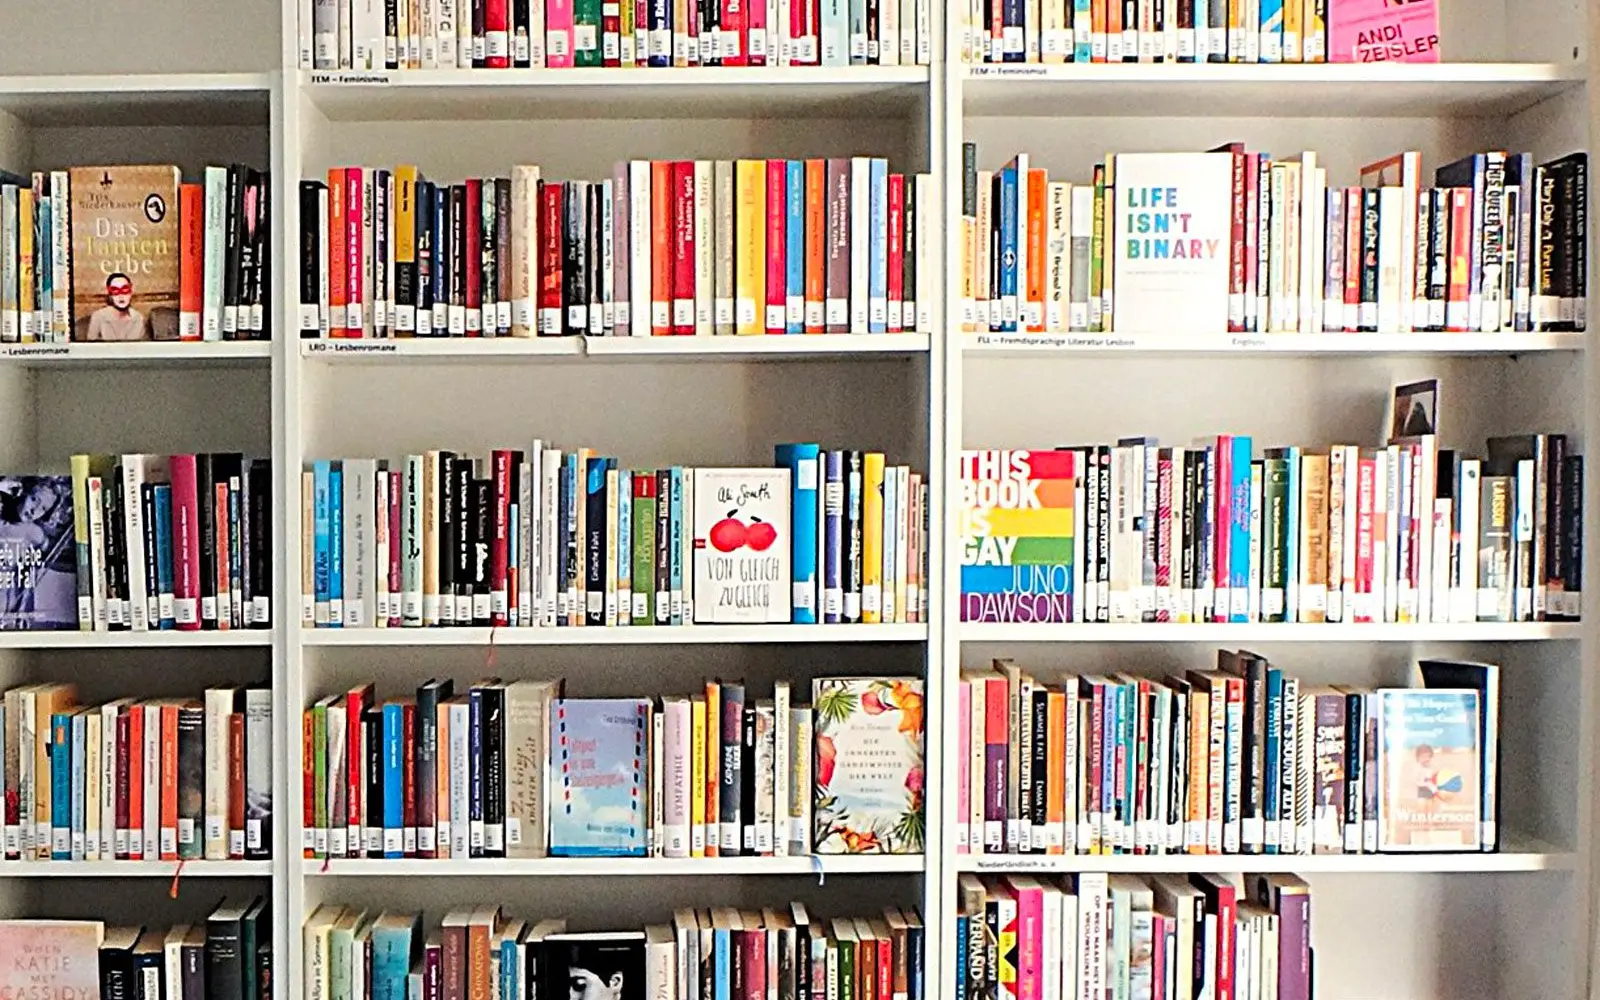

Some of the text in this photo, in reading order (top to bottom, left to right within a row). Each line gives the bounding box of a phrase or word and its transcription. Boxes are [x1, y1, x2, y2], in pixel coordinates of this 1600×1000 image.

[1357, 24, 1403, 46] ANDI
[339, 75, 389, 83] Feminismus
[998, 67, 1047, 75] Feminismus
[1128, 188, 1178, 208] LIFE
[1541, 178, 1555, 202] Mary
[1488, 190, 1502, 226] QUEER
[96, 217, 139, 238] Das
[1127, 213, 1192, 233] ISN'T
[86, 236, 168, 256] Tanten
[1127, 239, 1221, 259] BINARY
[100, 254, 154, 275] erbe
[9, 347, 69, 355] Lesbenromane
[335, 343, 396, 351] Lesbenromane
[961, 450, 1031, 481] THIS
[961, 479, 1042, 509] BOOK
[1492, 481, 1505, 527] LARSSON
[961, 508, 992, 538] IS
[591, 531, 600, 582] Einfache Fahrt
[960, 536, 1018, 566] GAY
[706, 556, 780, 582] VON GLEICH
[1003, 564, 1069, 594] JUNO
[967, 592, 1067, 624] DAWSON
[1036, 702, 1044, 760] SUMMER FATE
[1283, 742, 1295, 786] SOUND
[674, 754, 683, 817] SYMPATHIE
[1036, 780, 1044, 806] EMMA
[23, 945, 61, 954] WHEN
[14, 956, 71, 972] KATIE
[472, 935, 485, 1000] CHINATOWN
[31, 974, 56, 983] MET
[1, 986, 89, 1000] CASSIDY
